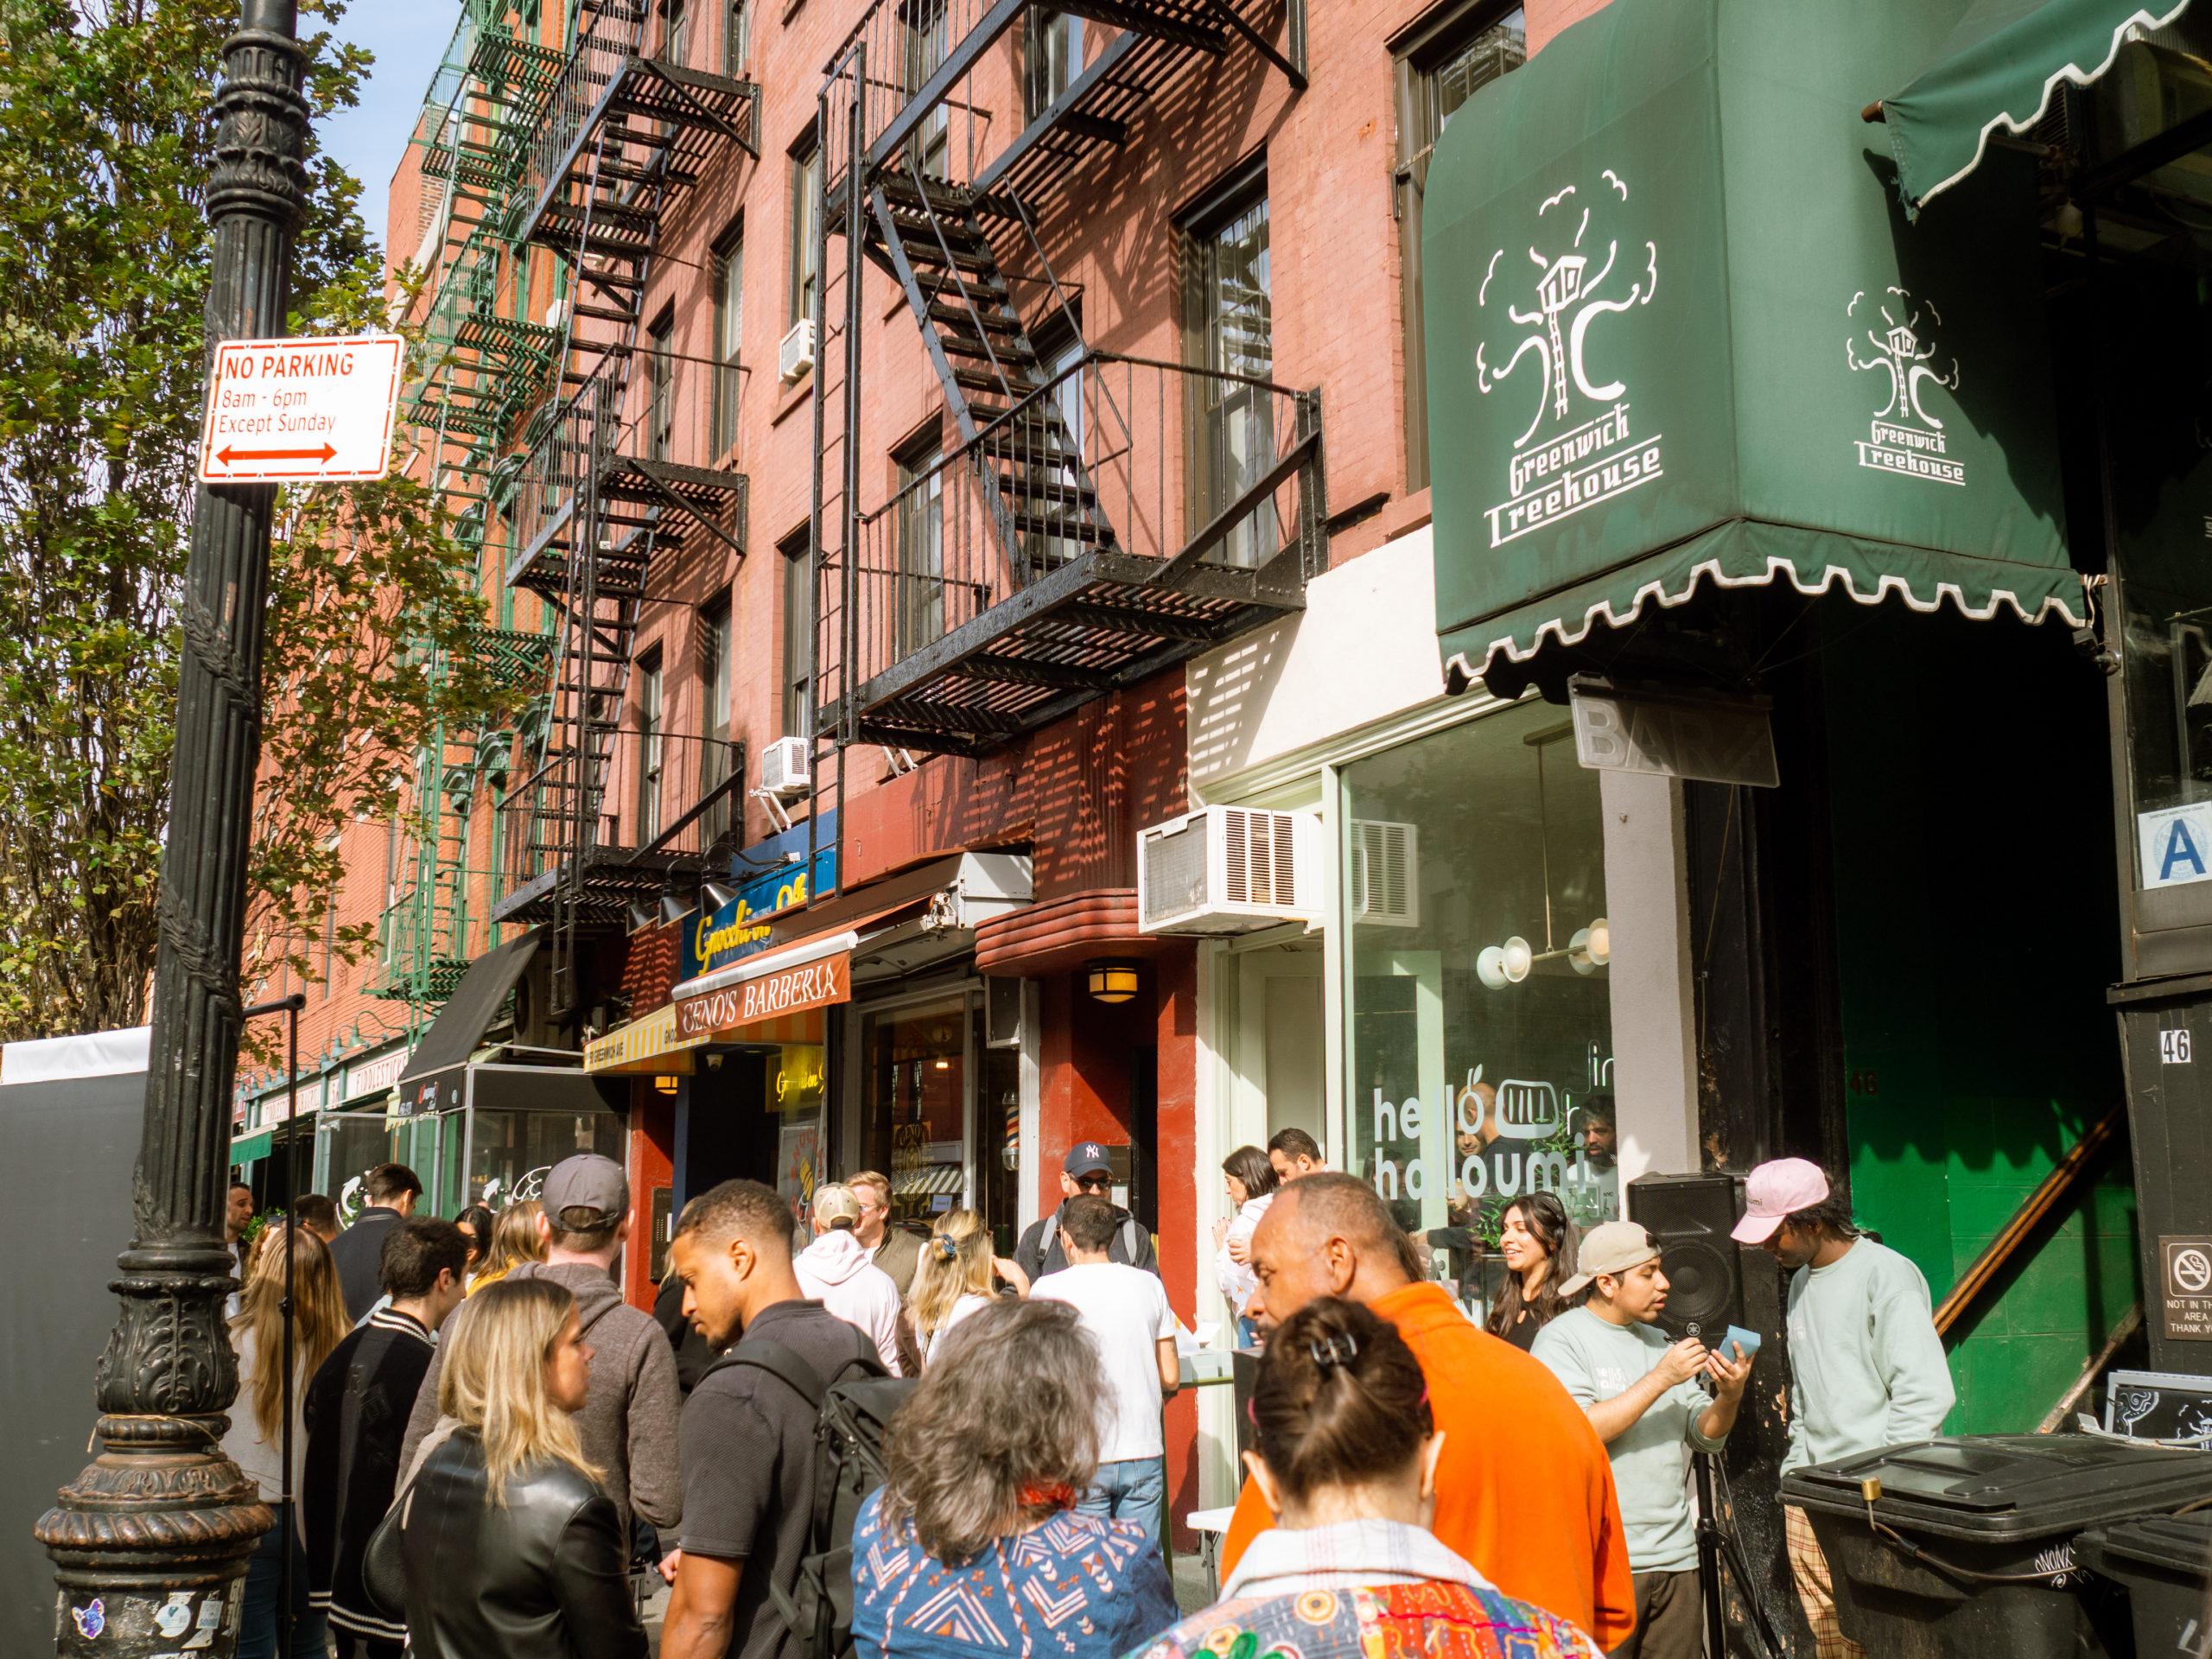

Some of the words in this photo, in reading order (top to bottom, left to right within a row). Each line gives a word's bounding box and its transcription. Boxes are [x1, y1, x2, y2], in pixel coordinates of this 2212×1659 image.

[226, 356, 254, 379] NO
[261, 353, 353, 378] PARKING
[222, 390, 256, 408] 8am
[273, 388, 308, 410] 6pm
[219, 415, 272, 436] Except
[278, 412, 337, 435] Sunday
[1872, 419, 1947, 454] Greenwich
[1510, 403, 1630, 499] Greenwich
[1853, 441, 1966, 482] Treehouse
[1484, 447, 1664, 550] Treehouse
[2159, 818, 2207, 880] A
[683, 989, 737, 1033] GENO'S
[742, 961, 838, 1019] BARBERIA
[2164, 1031, 2189, 1062] 46
[2166, 1300, 2186, 1309] NOT
[2190, 1300, 2199, 1309] IN
[2202, 1300, 2212, 1309] TH
[2184, 1313, 2209, 1322] AREA
[2170, 1323, 2202, 1333] THANK
